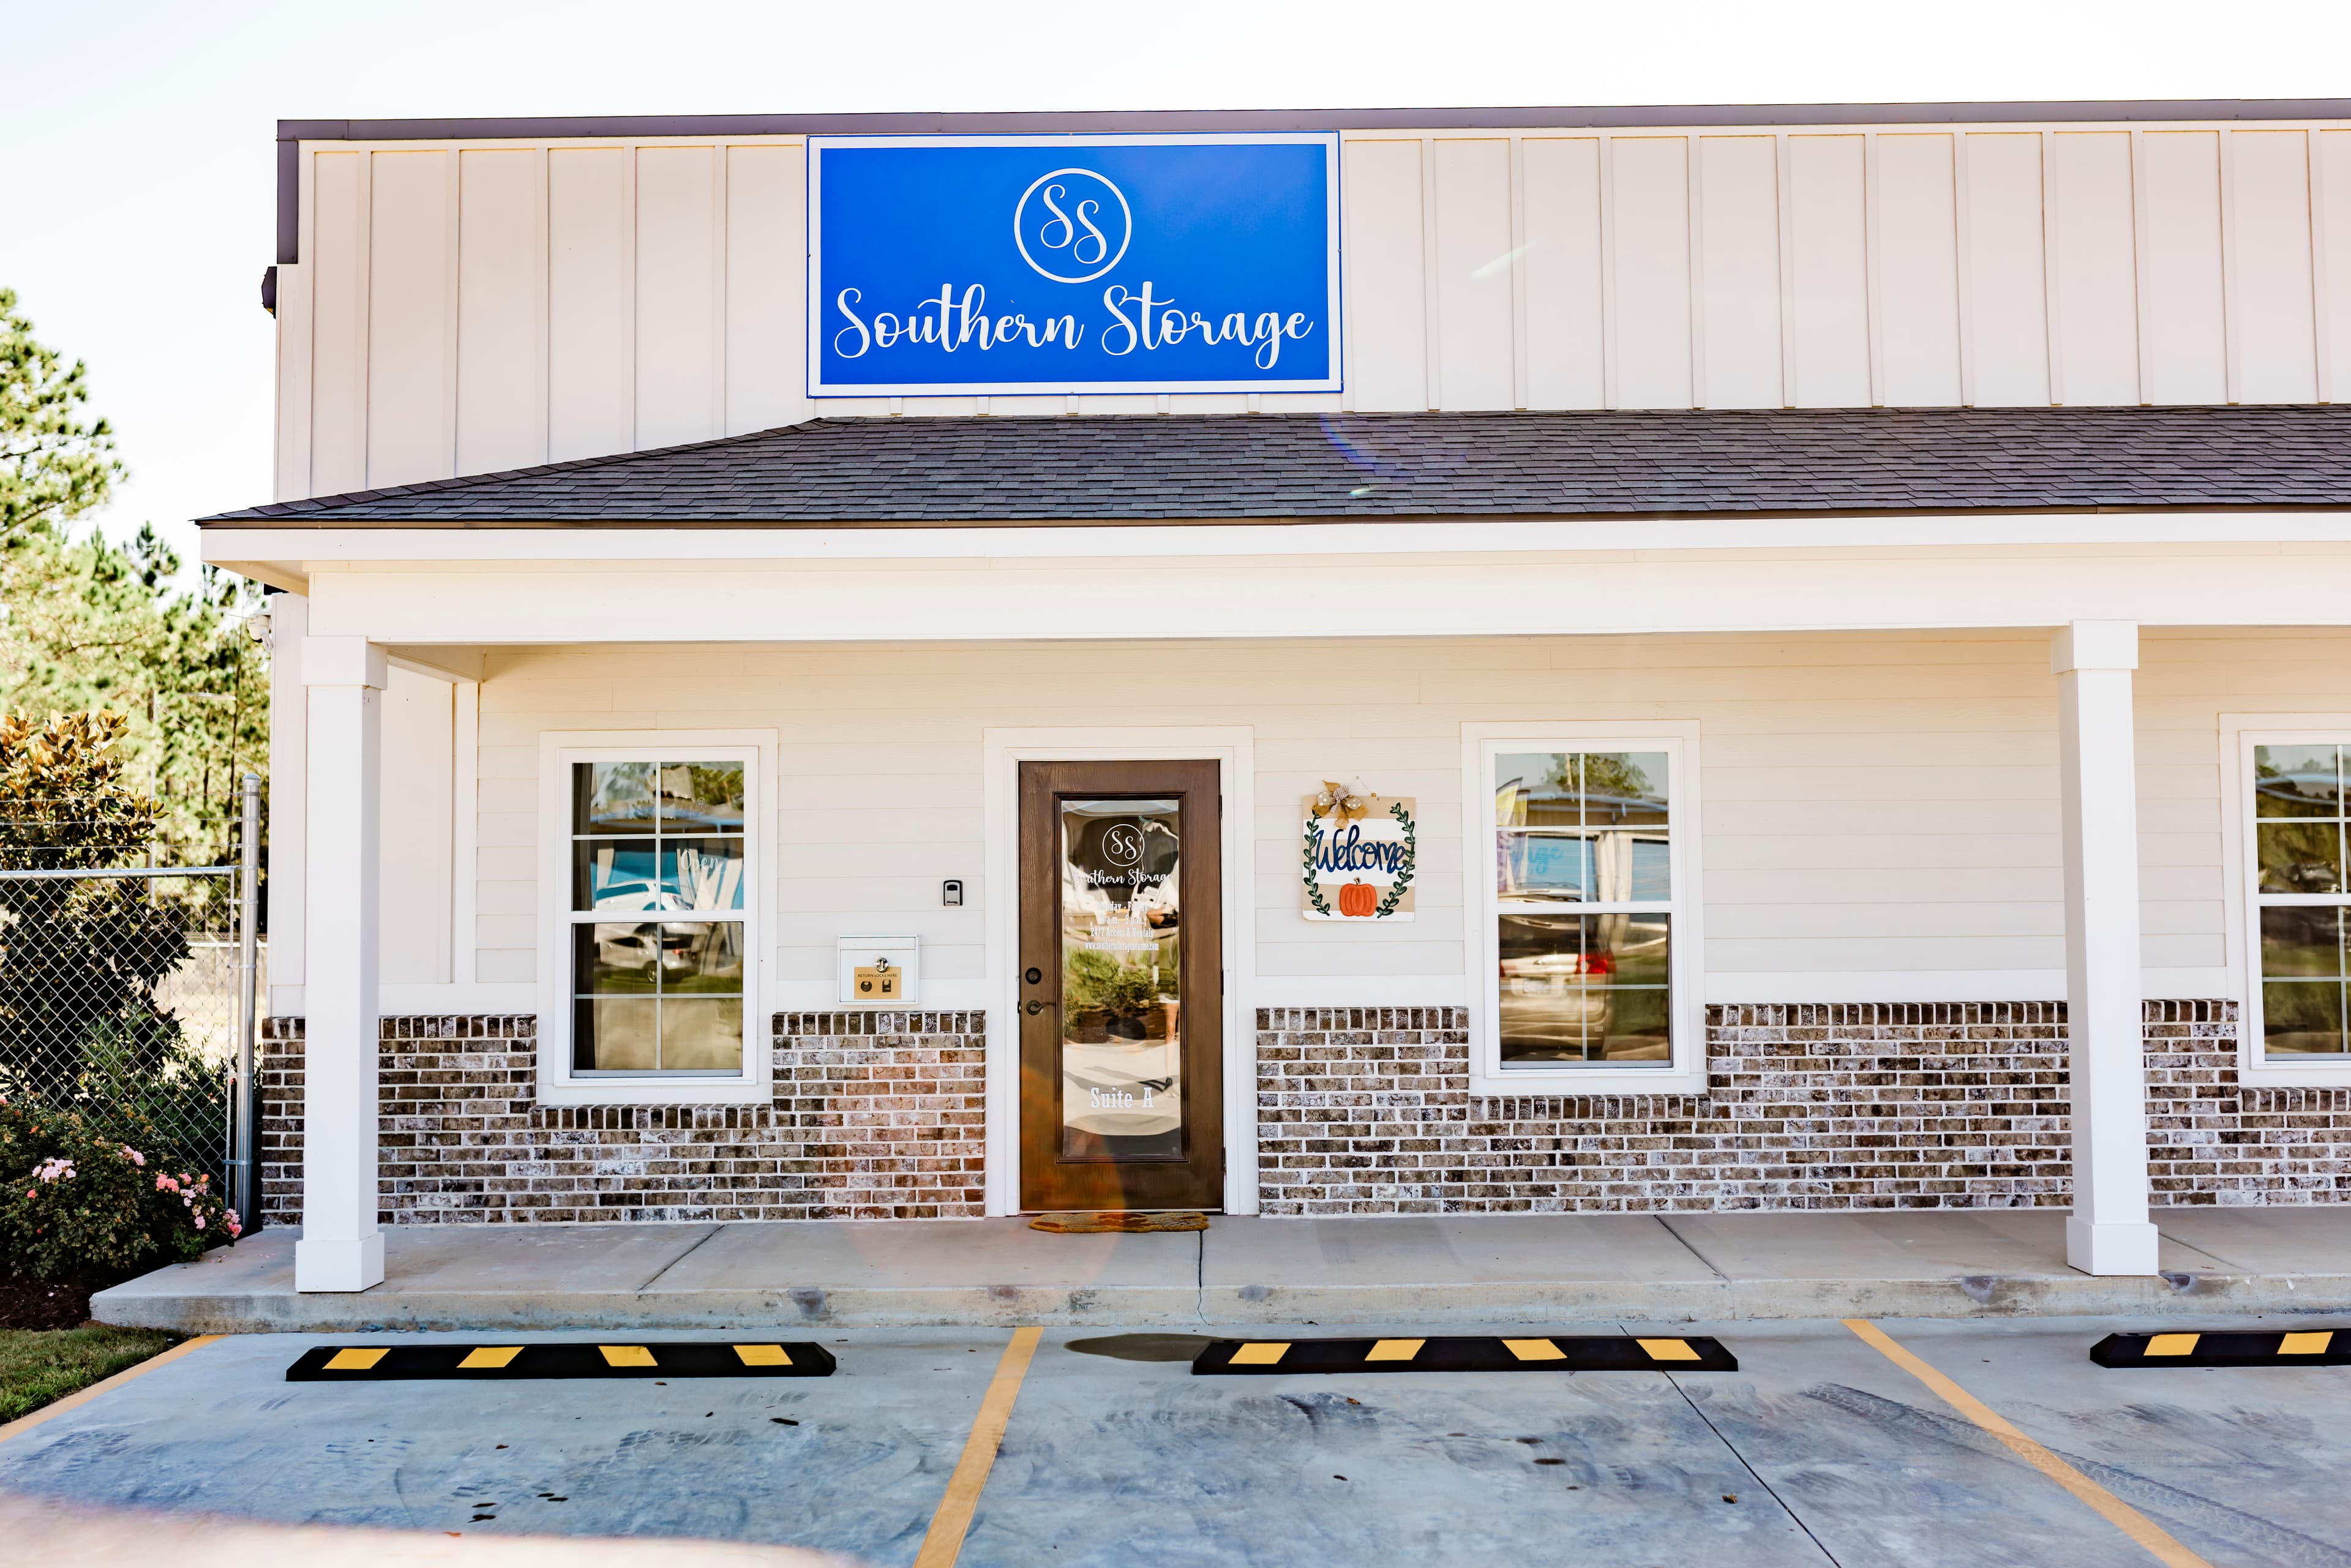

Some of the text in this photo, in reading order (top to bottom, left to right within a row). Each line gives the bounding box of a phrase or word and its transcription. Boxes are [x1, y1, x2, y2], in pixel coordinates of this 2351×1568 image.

[1041, 184, 1107, 264] SS
[834, 281, 1314, 369] Southern Storage
[1111, 830, 1137, 860] SS
[1313, 825, 1407, 874] Welcome
[1072, 868, 1172, 887] Southern Storage
[1128, 901, 1148, 914] Fray
[1090, 927, 1104, 937] 24/7
[1106, 927, 1125, 937] Access
[1090, 1087, 1155, 1108] Suite A
